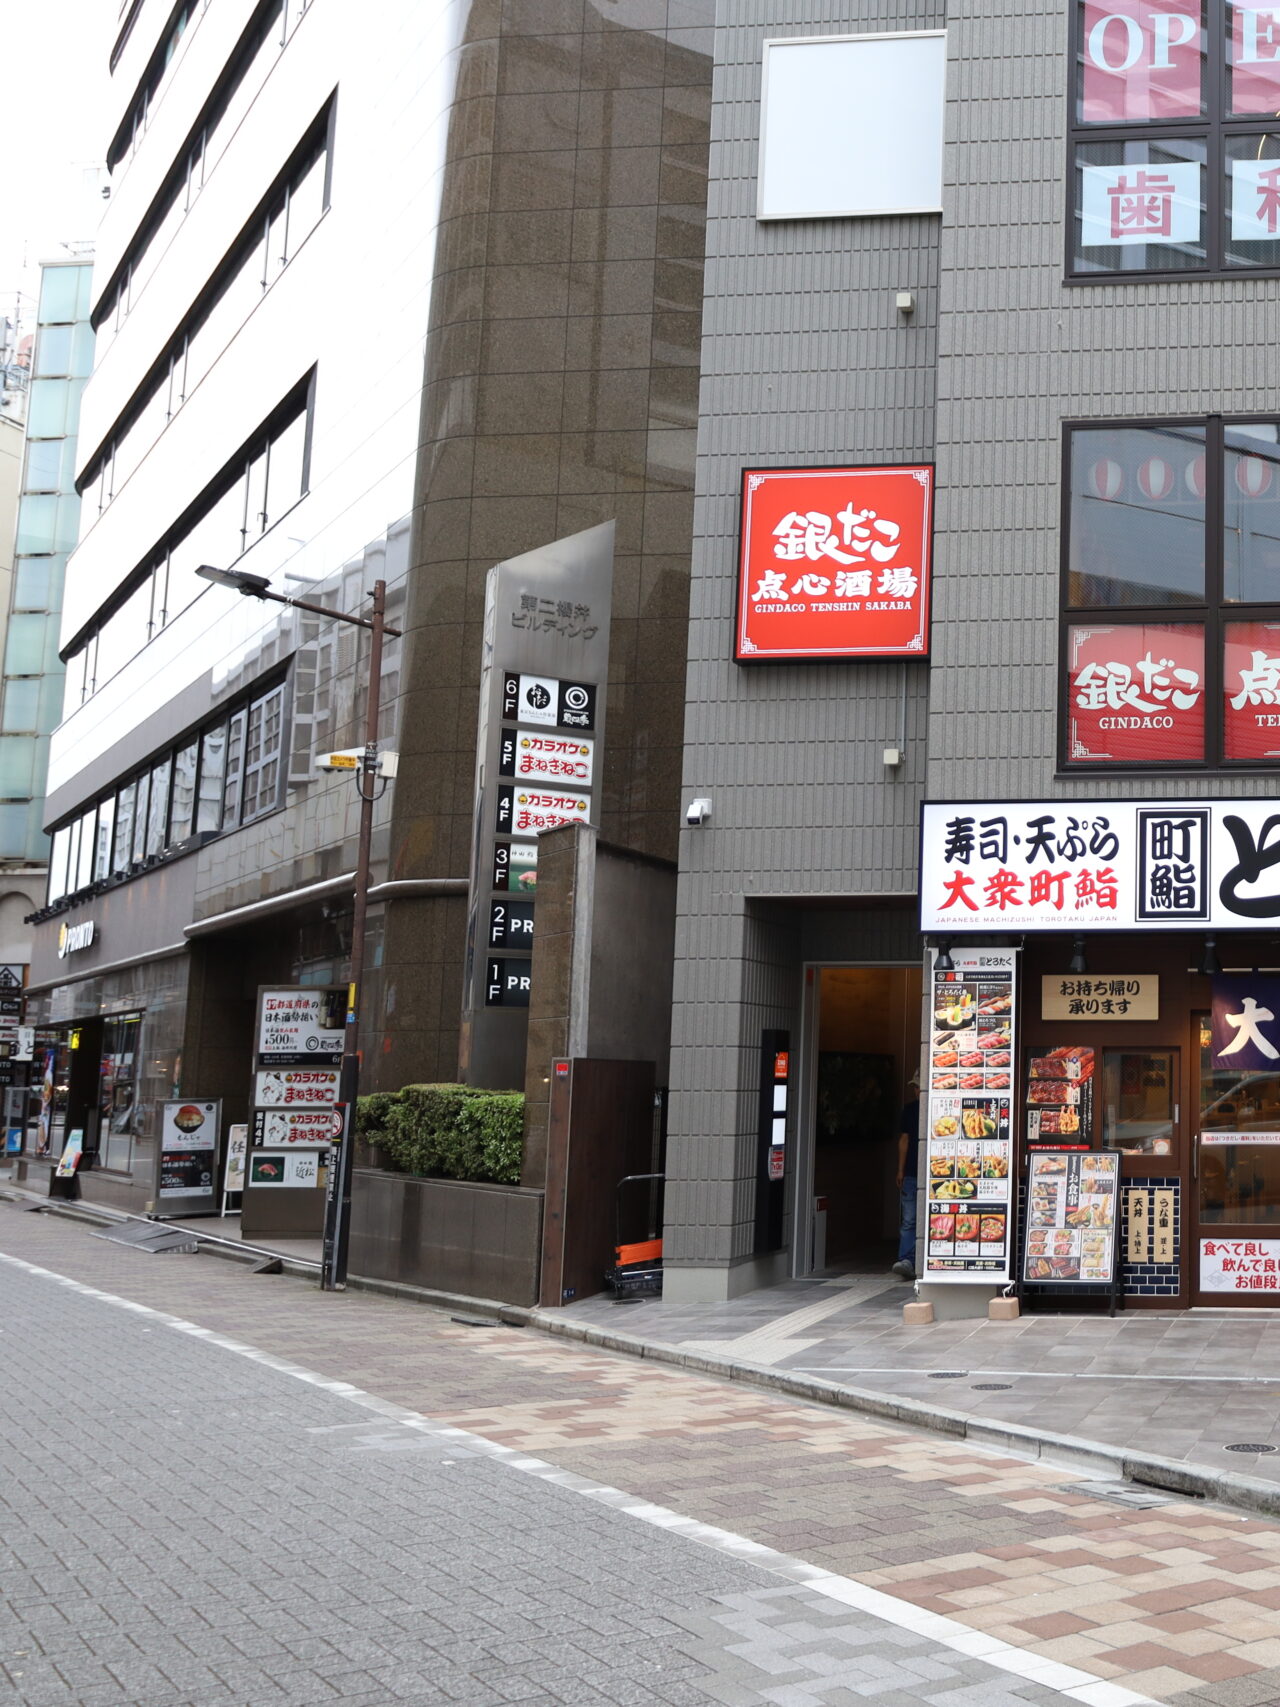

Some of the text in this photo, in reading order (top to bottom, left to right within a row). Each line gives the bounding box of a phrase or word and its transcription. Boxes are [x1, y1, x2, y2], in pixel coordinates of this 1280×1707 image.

[772, 502, 900, 564] 銀だこ
[752, 567, 918, 601] 点心酒場
[755, 601, 912, 613] GINDACO TENSHIN SAKABA
[512, 612, 598, 640] ビルディング
[1073, 651, 1199, 713] 銀だこ
[1099, 717, 1174, 729] GINDACO
[530, 739, 580, 755] カラオケ
[520, 754, 588, 778] まねきねこ
[528, 795, 578, 810] カラオケ
[1150, 819, 1198, 910] 町鮨
[936, 867, 1120, 911] 大衆町鮨
[986, 957, 1012, 966] とろたく
[1060, 980, 1140, 996] お持ち帰り
[1068, 998, 1131, 1014] 承ります
[293, 1073, 329, 1083] カラオケ
[284, 1087, 335, 1103] まねきねこ
[296, 1114, 330, 1125] カラオケ
[1203, 1241, 1269, 1256] 食べて良し
